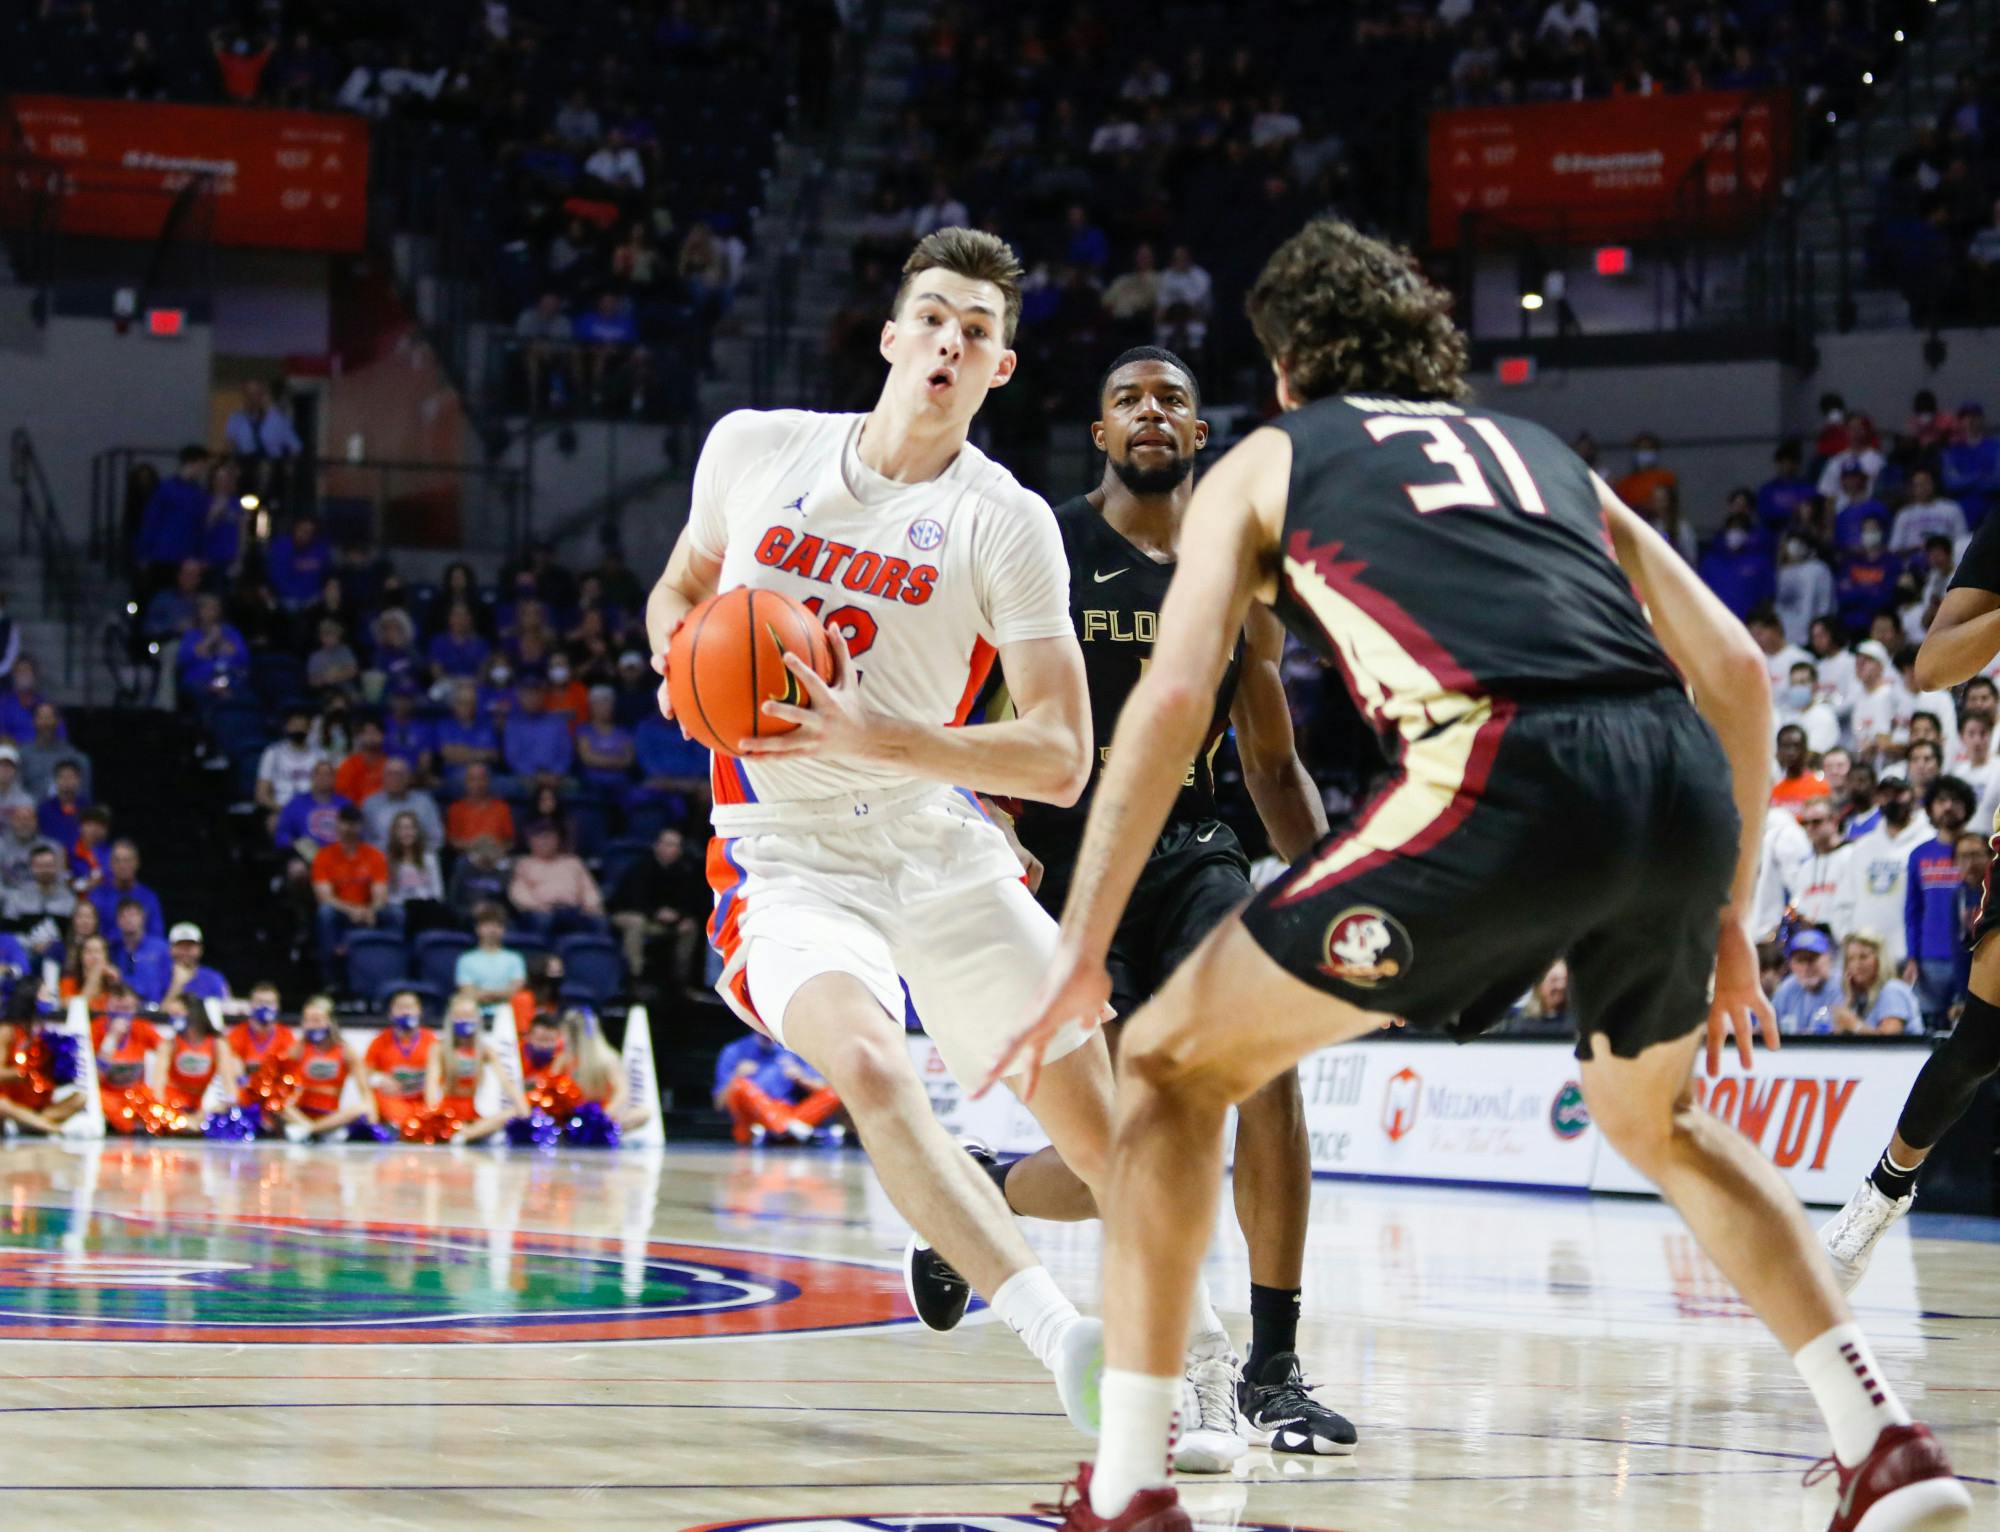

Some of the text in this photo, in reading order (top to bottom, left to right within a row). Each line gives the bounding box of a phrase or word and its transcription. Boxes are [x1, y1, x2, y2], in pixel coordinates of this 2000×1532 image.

[1362, 414, 1548, 516] 31
[754, 525, 940, 606] GATORS
[911, 522, 942, 547] SEC
[1082, 610, 1162, 642] FLO
[1311, 1054, 1367, 1105] Hill
[1697, 1077, 1859, 1170] OWDY
